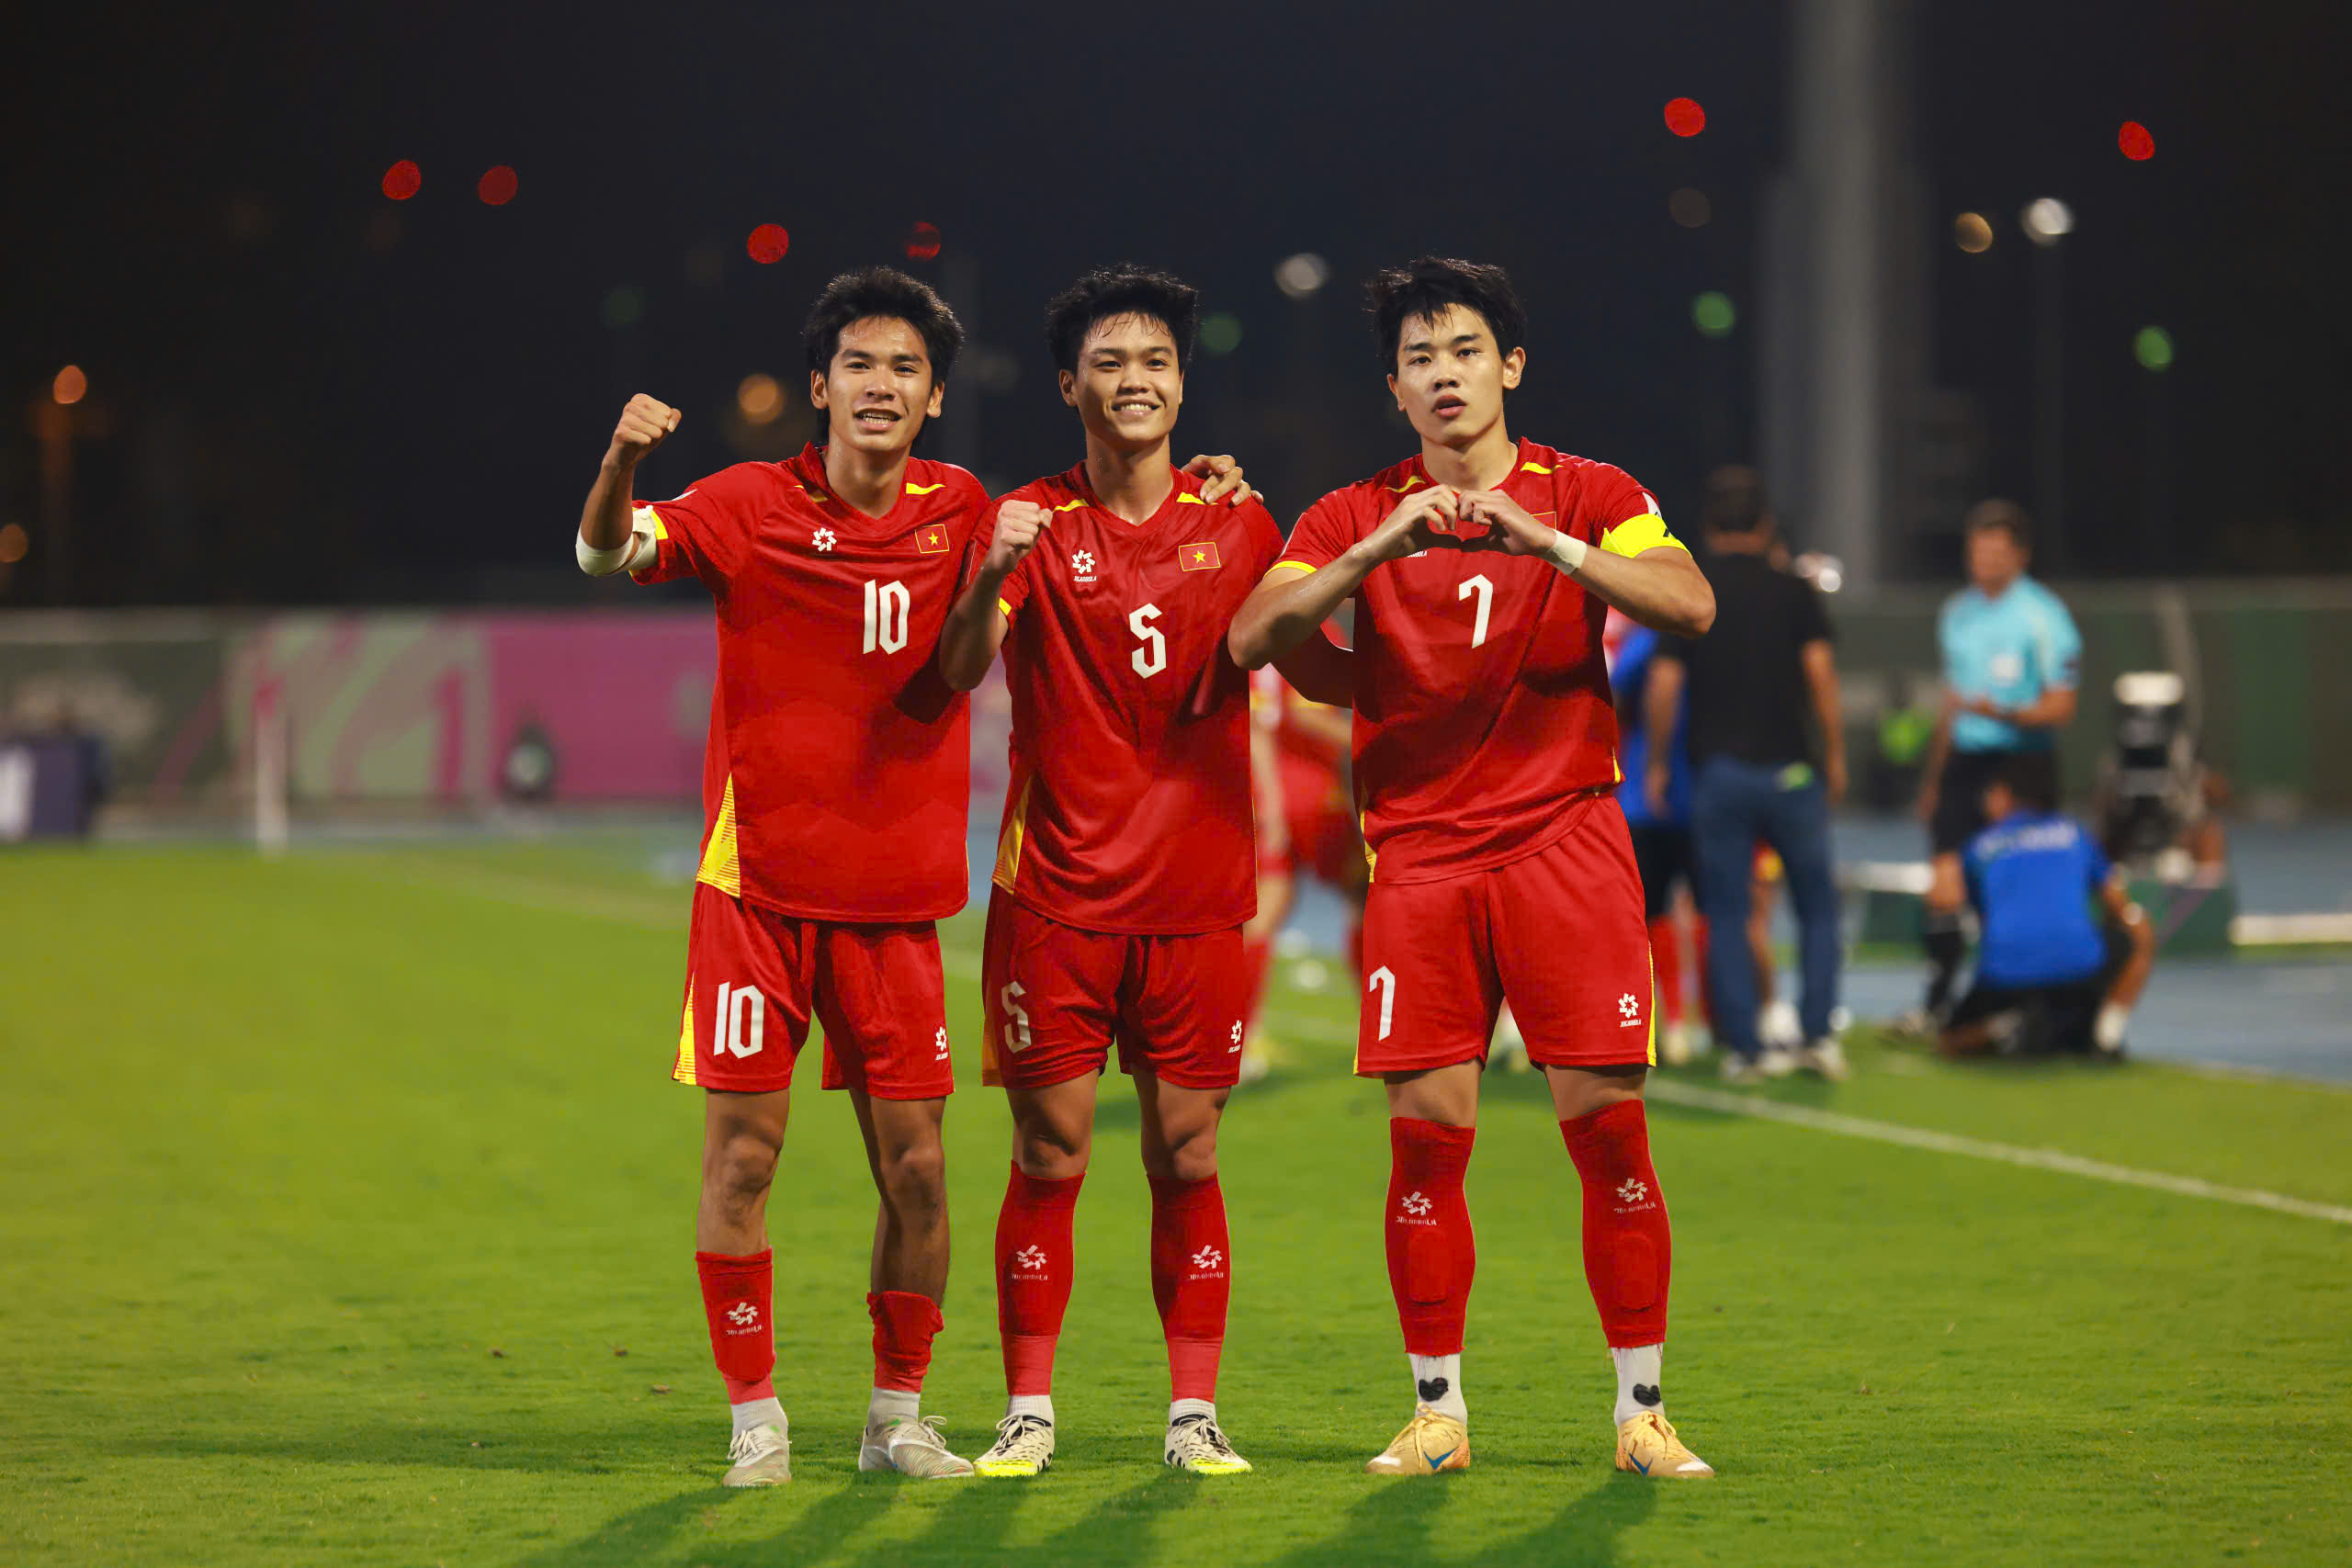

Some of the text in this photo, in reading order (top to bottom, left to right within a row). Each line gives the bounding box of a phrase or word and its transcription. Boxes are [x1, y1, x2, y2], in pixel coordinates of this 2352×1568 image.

[863, 579, 910, 655] 10
[1128, 603, 1167, 679] 5
[1458, 574, 1493, 649] 7
[713, 981, 765, 1059] 10
[1001, 980, 1032, 1054] 5
[1369, 965, 1396, 1041] 7
